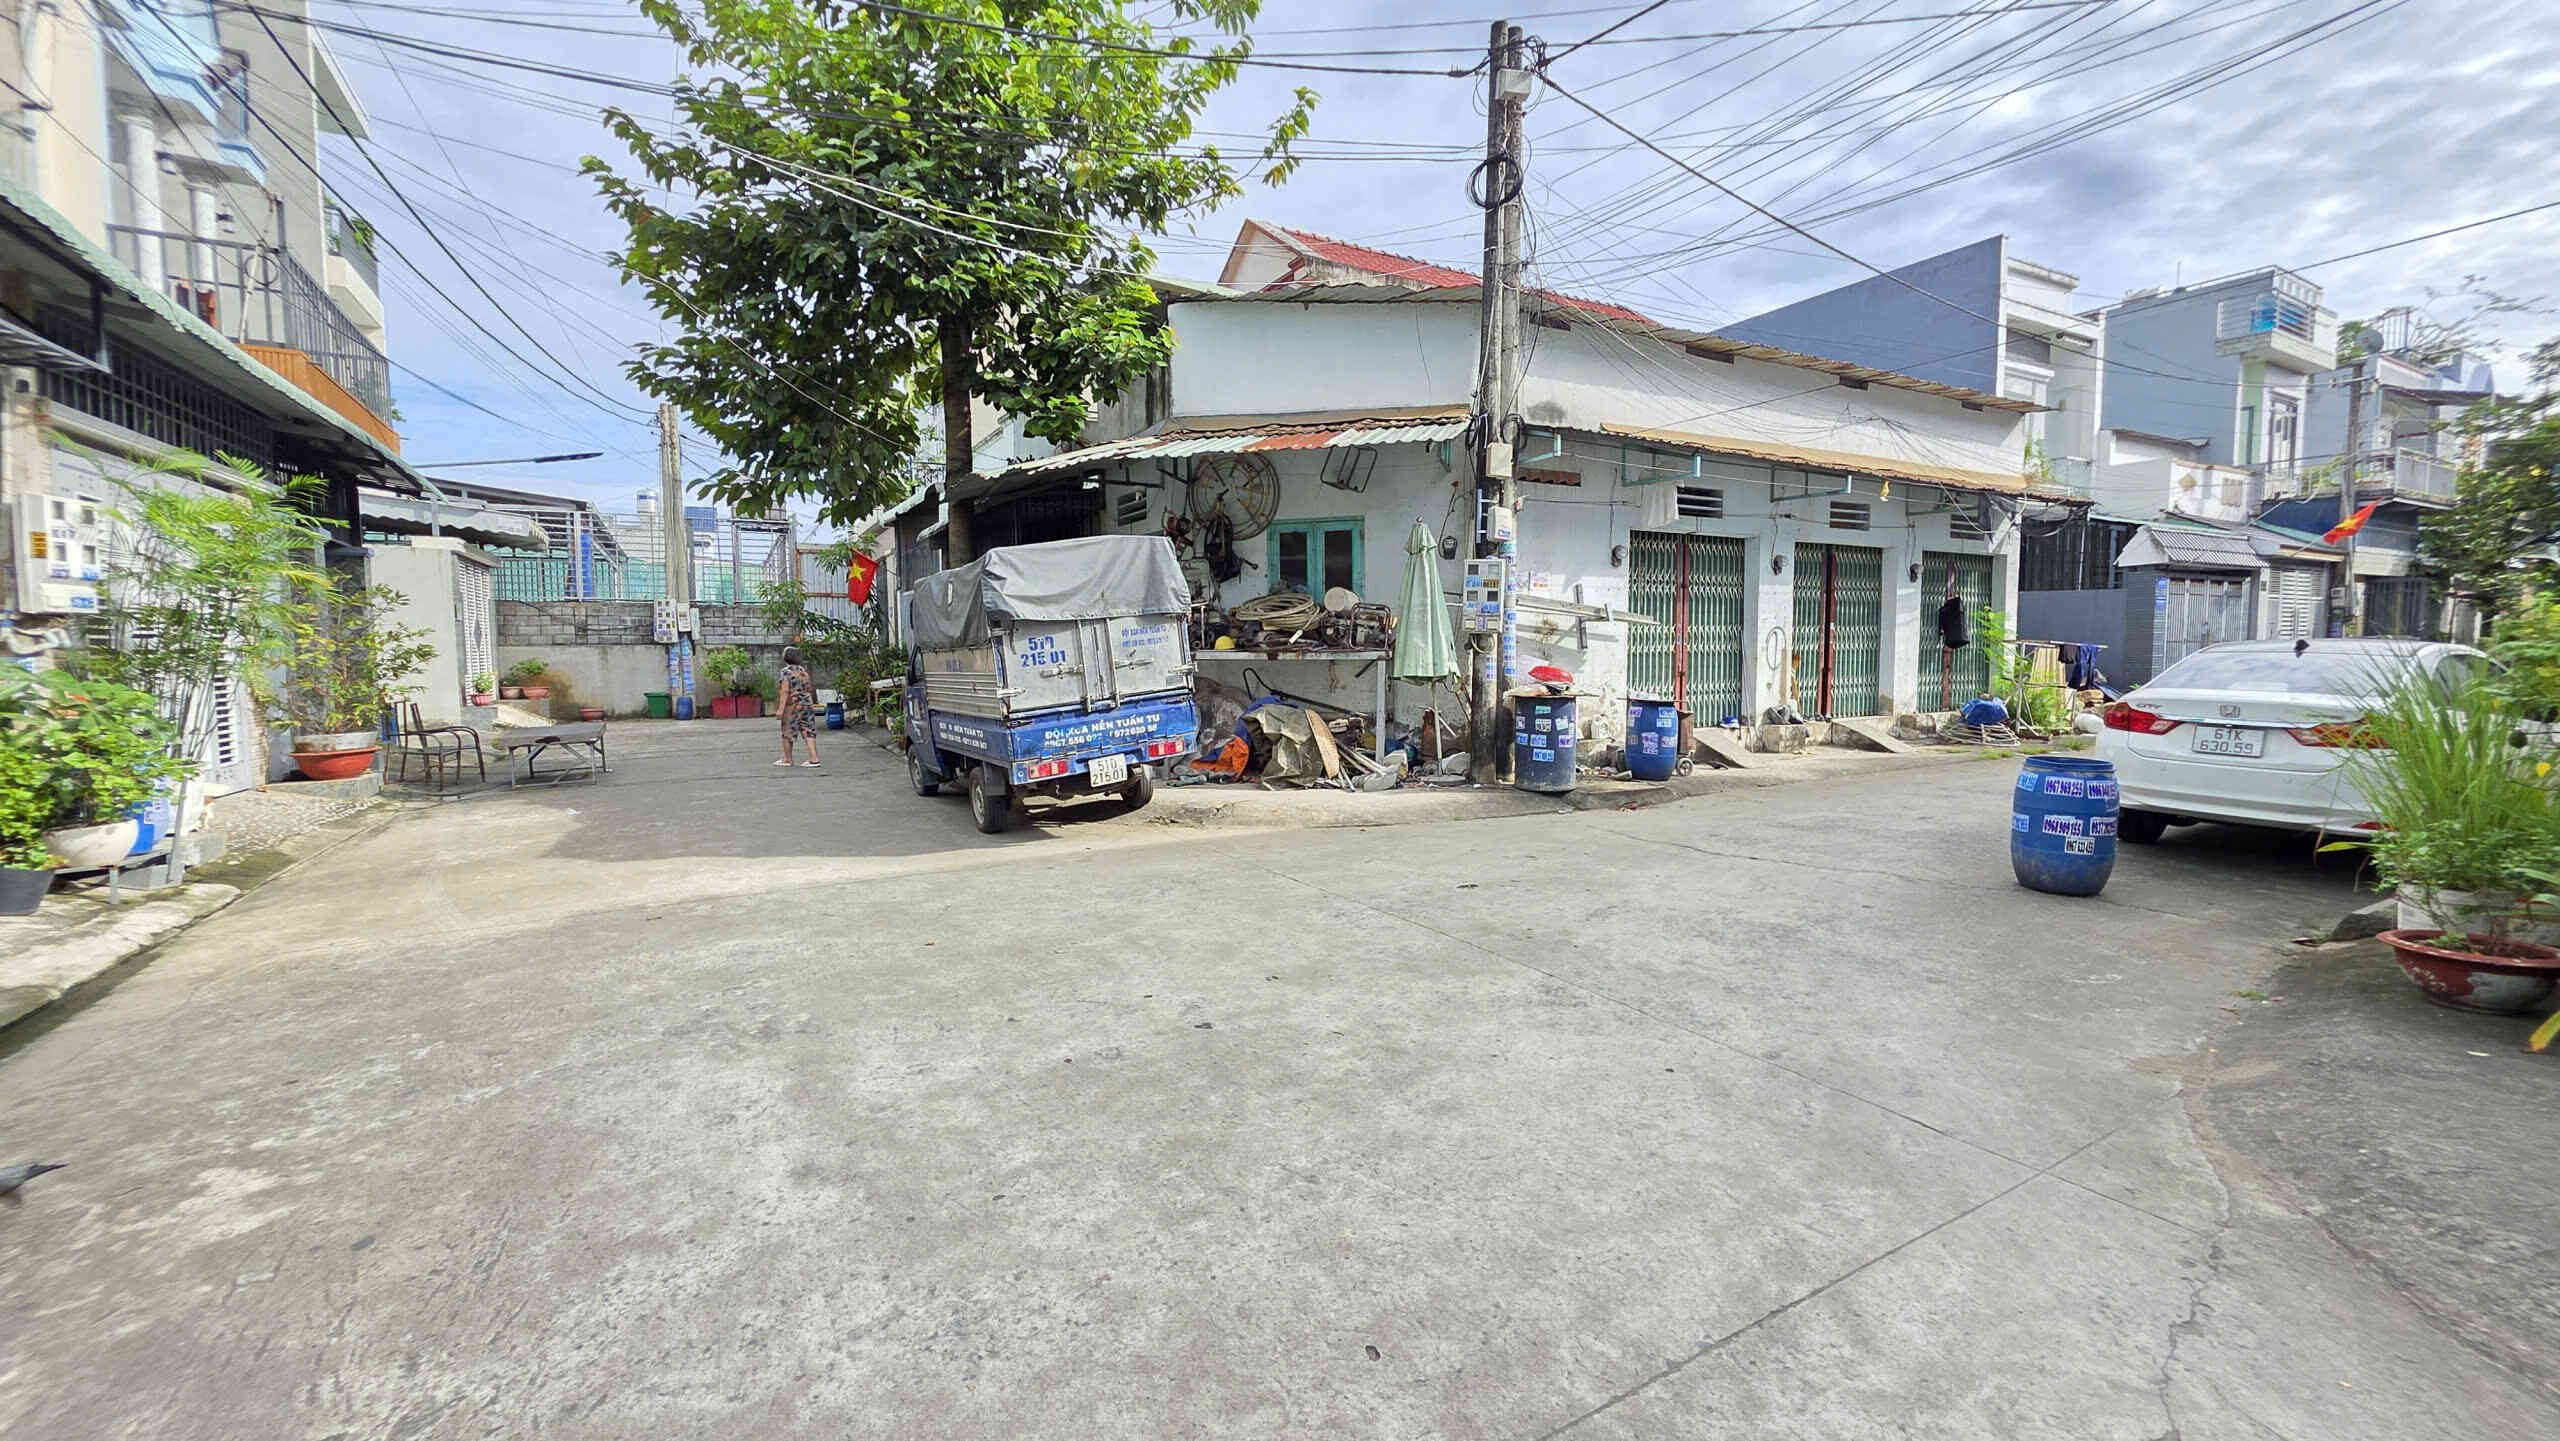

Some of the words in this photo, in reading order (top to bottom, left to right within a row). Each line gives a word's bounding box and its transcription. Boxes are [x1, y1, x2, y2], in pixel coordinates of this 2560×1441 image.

[2214, 728, 2244, 741] 61K
[2199, 740, 2254, 754] 630.59
[1098, 758, 1118, 771] 51D
